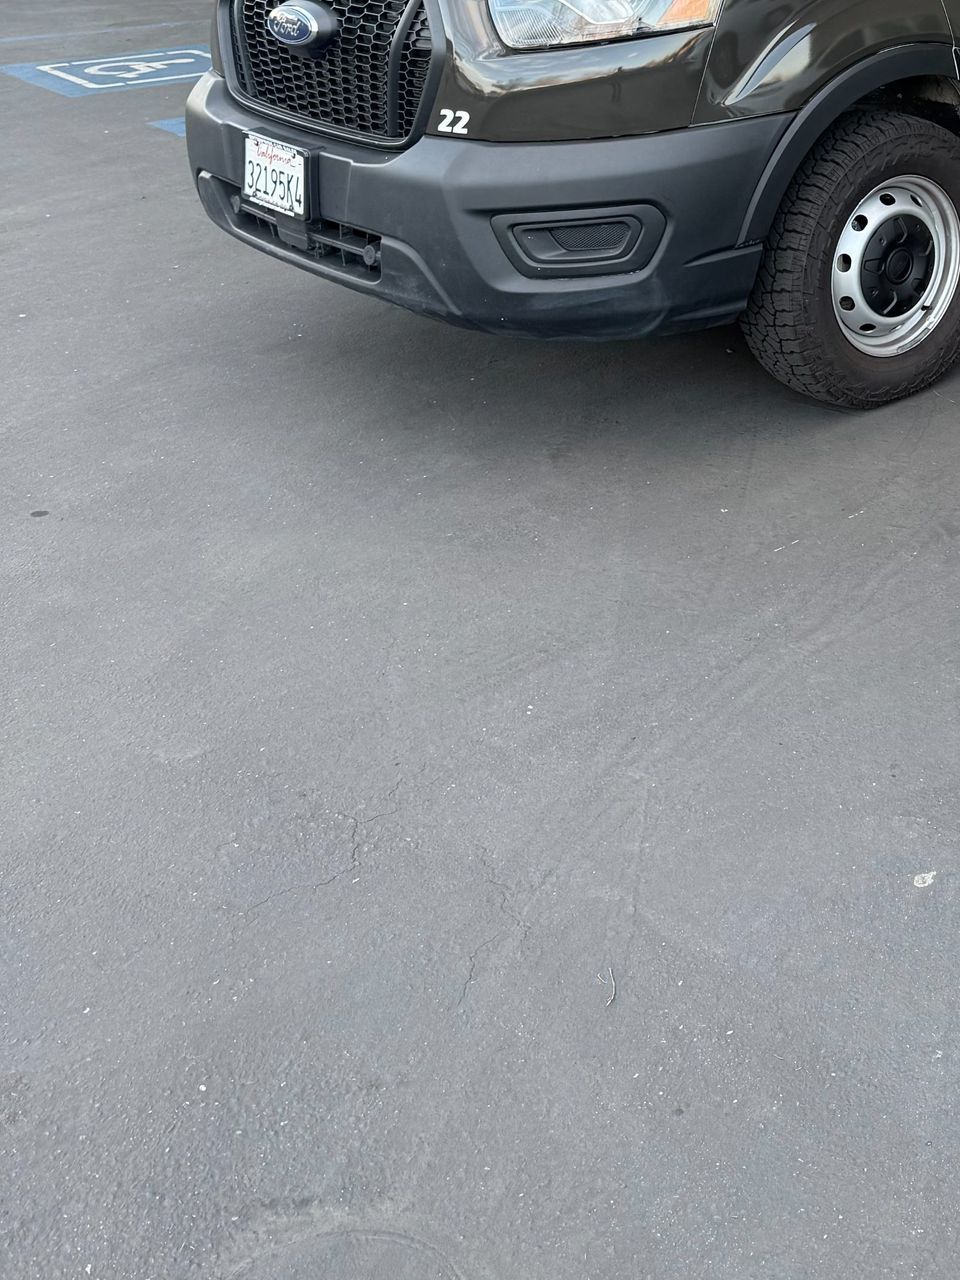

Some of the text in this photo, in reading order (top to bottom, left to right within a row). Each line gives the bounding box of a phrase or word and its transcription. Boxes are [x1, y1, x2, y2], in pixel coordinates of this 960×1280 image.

[272, 15, 302, 37] Ford
[437, 109, 471, 135] 22
[247, 160, 302, 208] 32195K4
